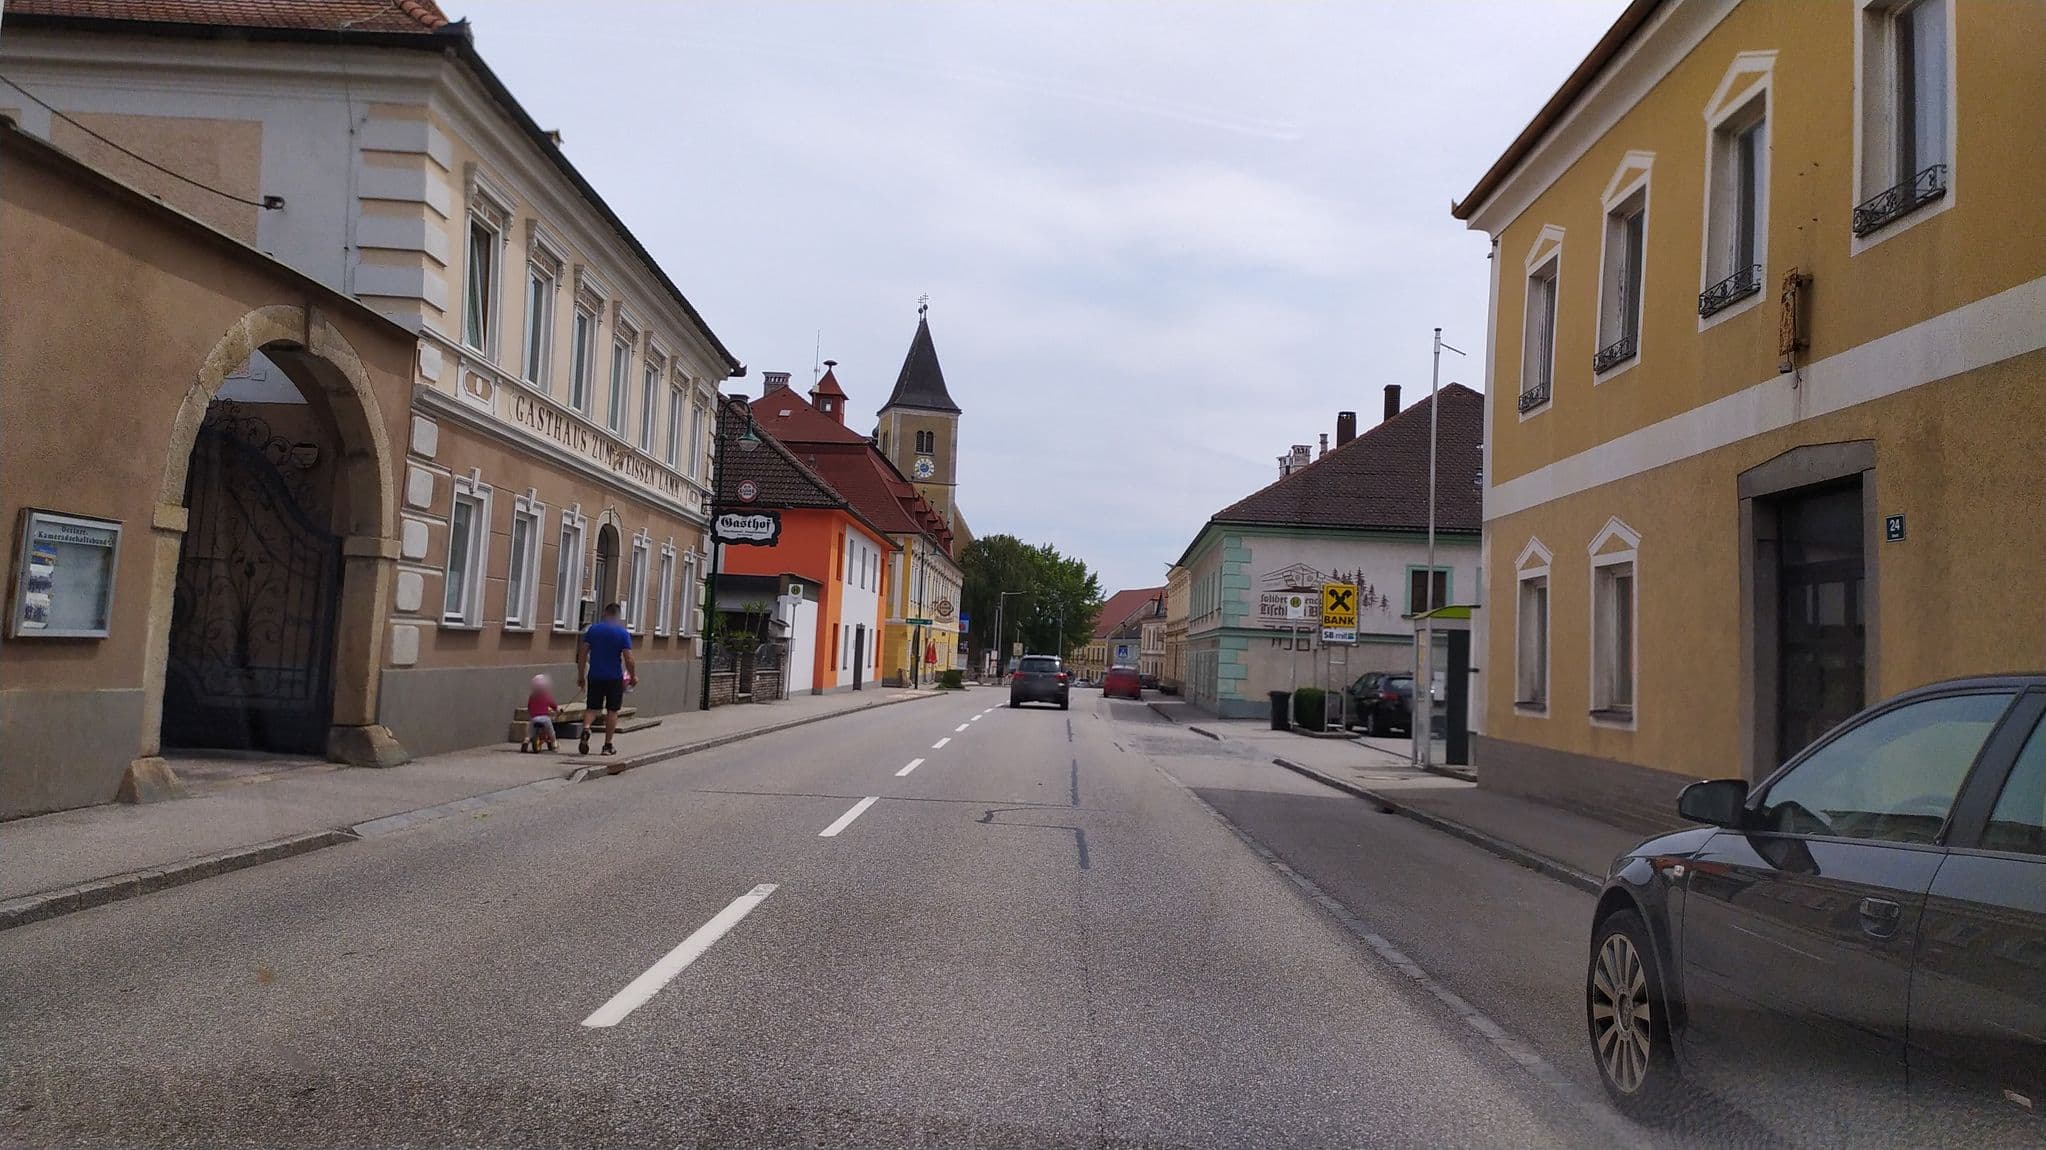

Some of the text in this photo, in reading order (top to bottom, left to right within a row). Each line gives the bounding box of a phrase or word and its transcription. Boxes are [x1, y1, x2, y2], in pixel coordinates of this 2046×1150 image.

[515, 395, 587, 453] GASTHAUS
[592, 434, 614, 466] ZUM
[720, 517, 771, 532] Gasthof
[1890, 519, 1900, 531] 24
[1324, 615, 1355, 625] BANK
[1323, 631, 1335, 640] SB
